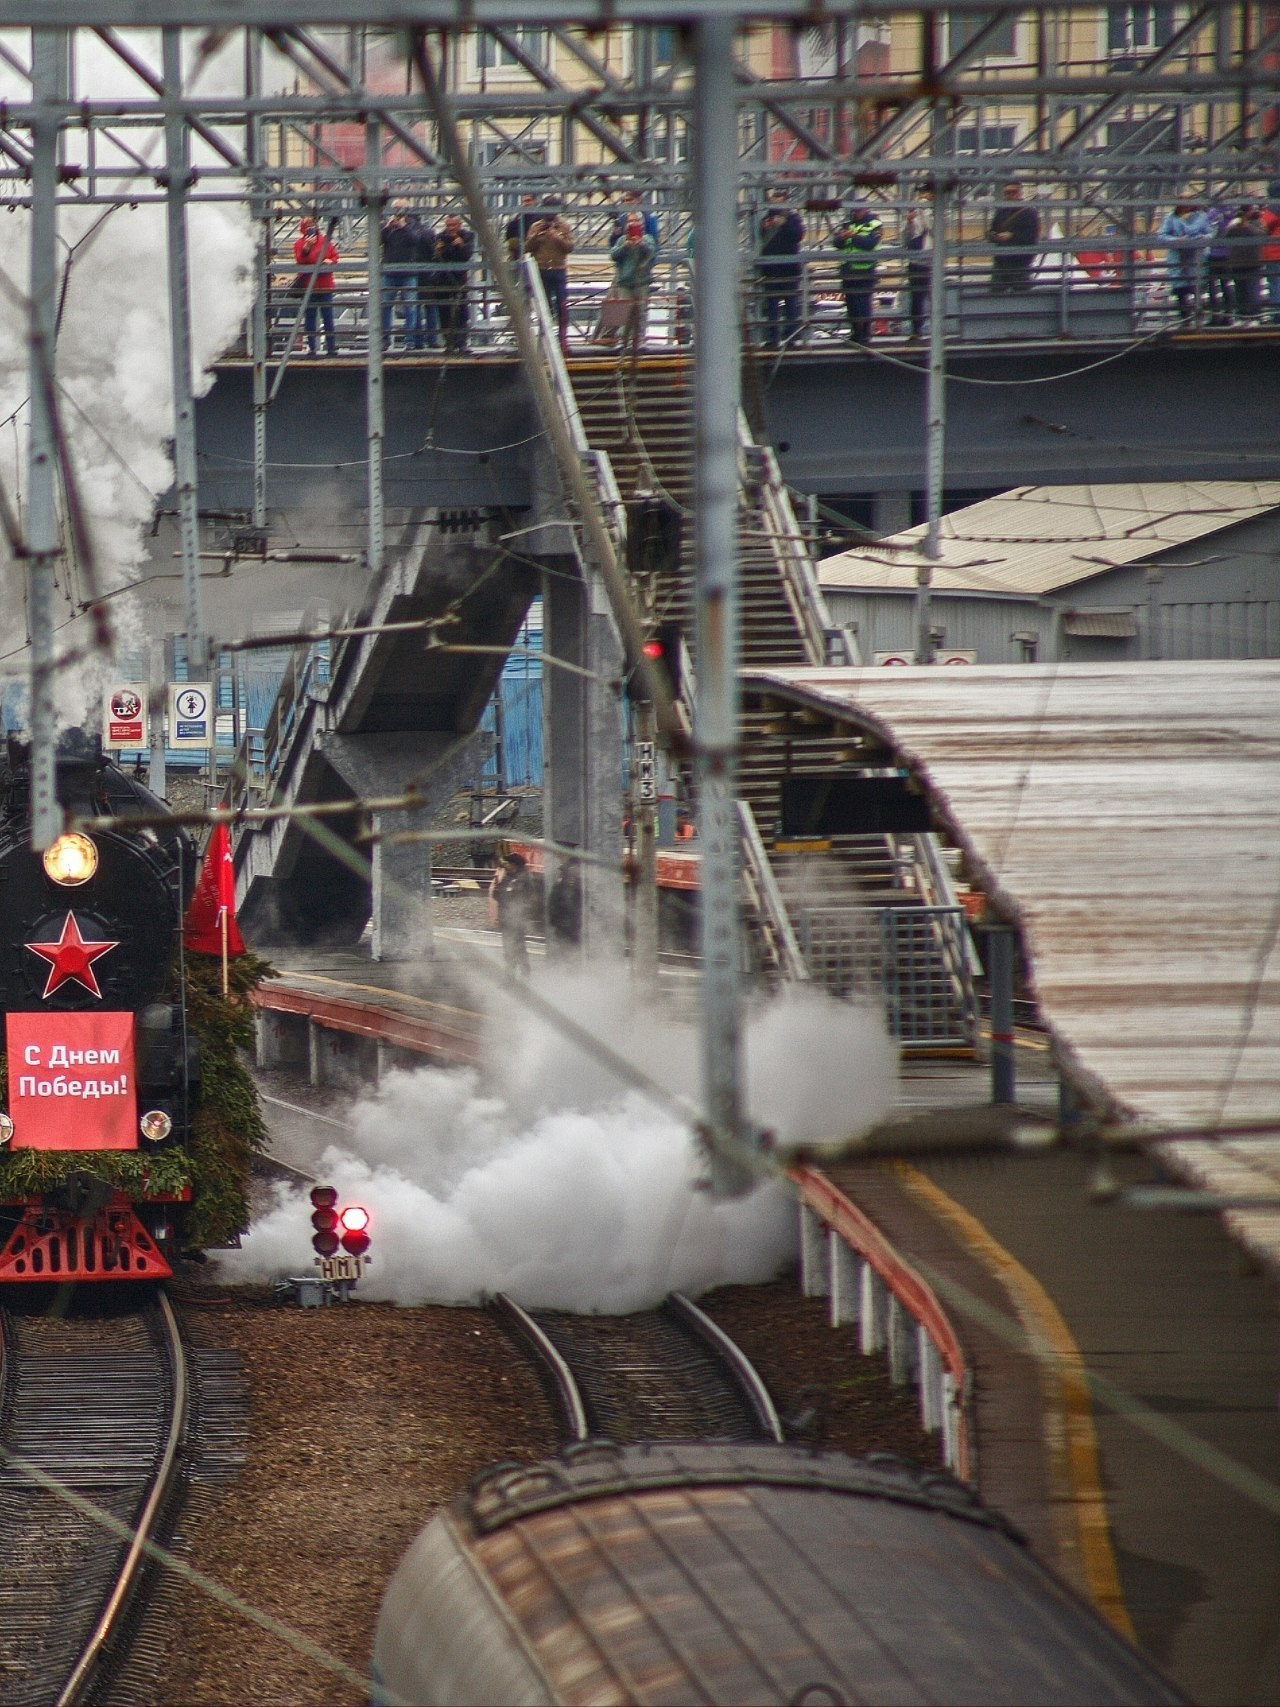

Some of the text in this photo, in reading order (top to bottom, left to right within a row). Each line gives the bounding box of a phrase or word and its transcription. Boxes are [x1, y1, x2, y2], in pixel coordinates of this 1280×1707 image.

[24, 1045, 120, 1069] С Днем
[19, 1074, 127, 1099] Победы!
